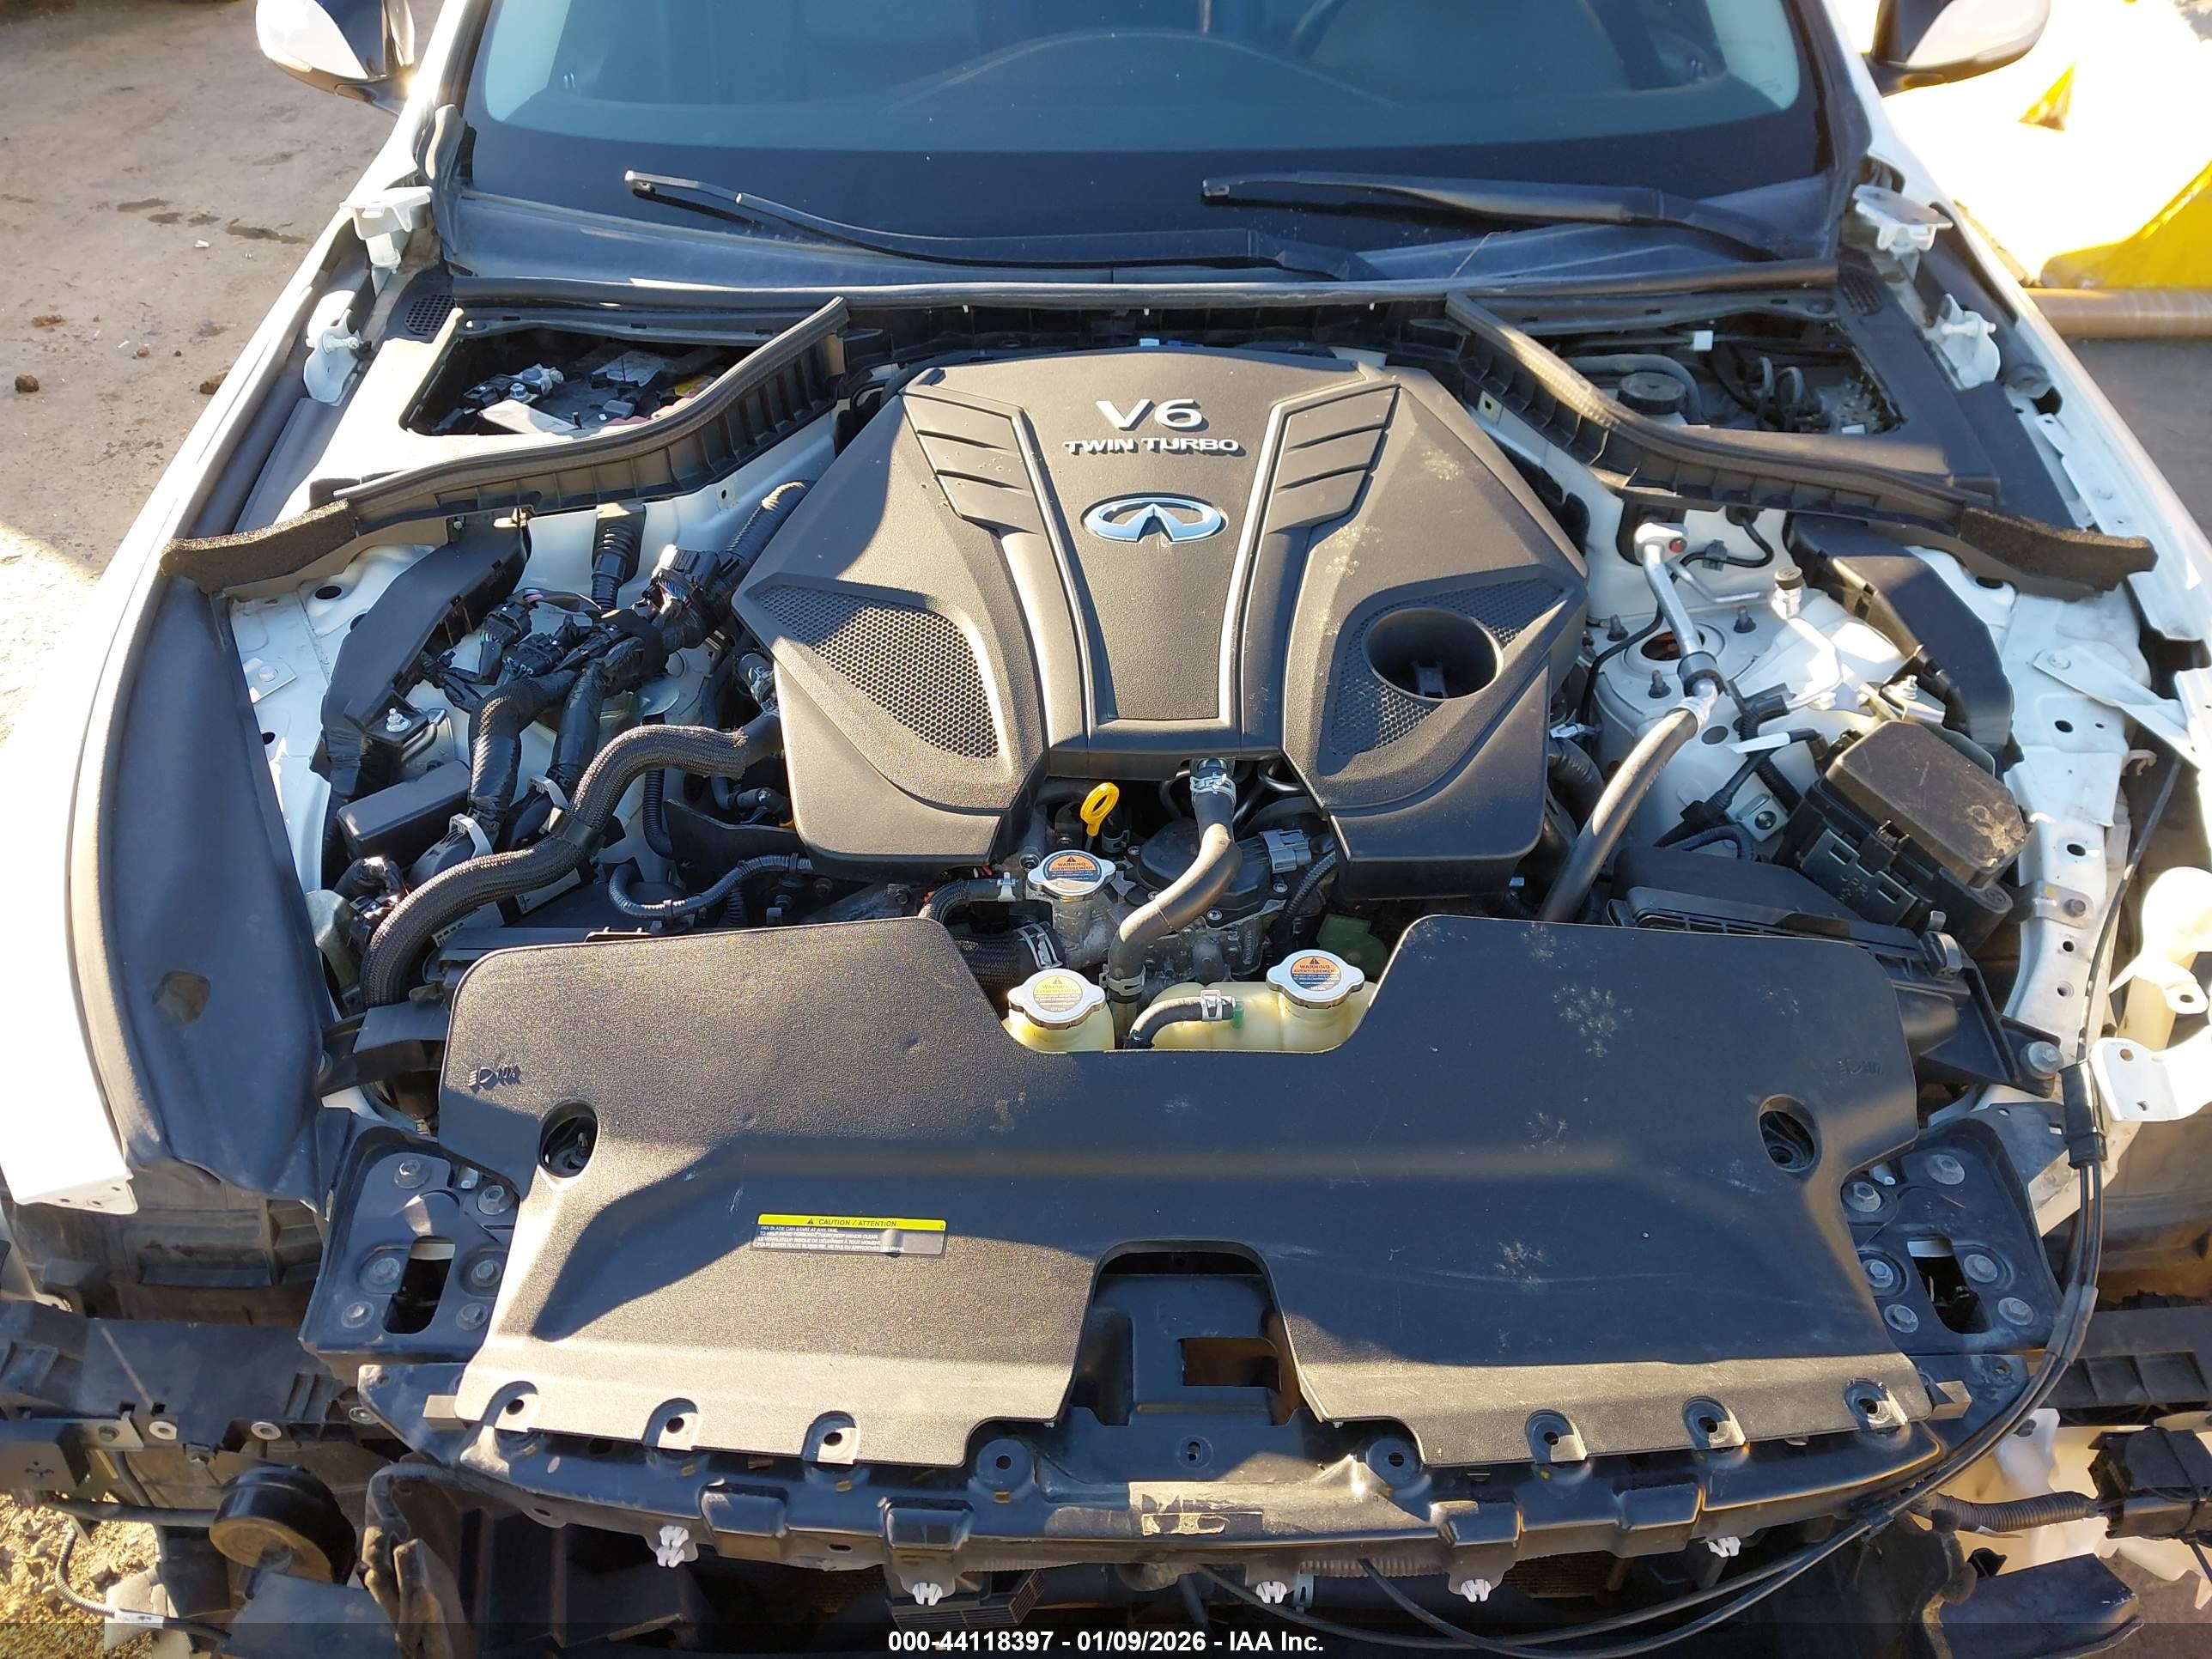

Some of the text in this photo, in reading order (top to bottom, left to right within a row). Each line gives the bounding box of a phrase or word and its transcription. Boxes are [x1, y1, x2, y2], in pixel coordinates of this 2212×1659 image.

[1096, 398, 1206, 430] V6
[1063, 437, 1243, 456] TWIN TURBO
[818, 1218, 850, 1227] CAUTION
[857, 1219, 897, 1228] ATTENTION
